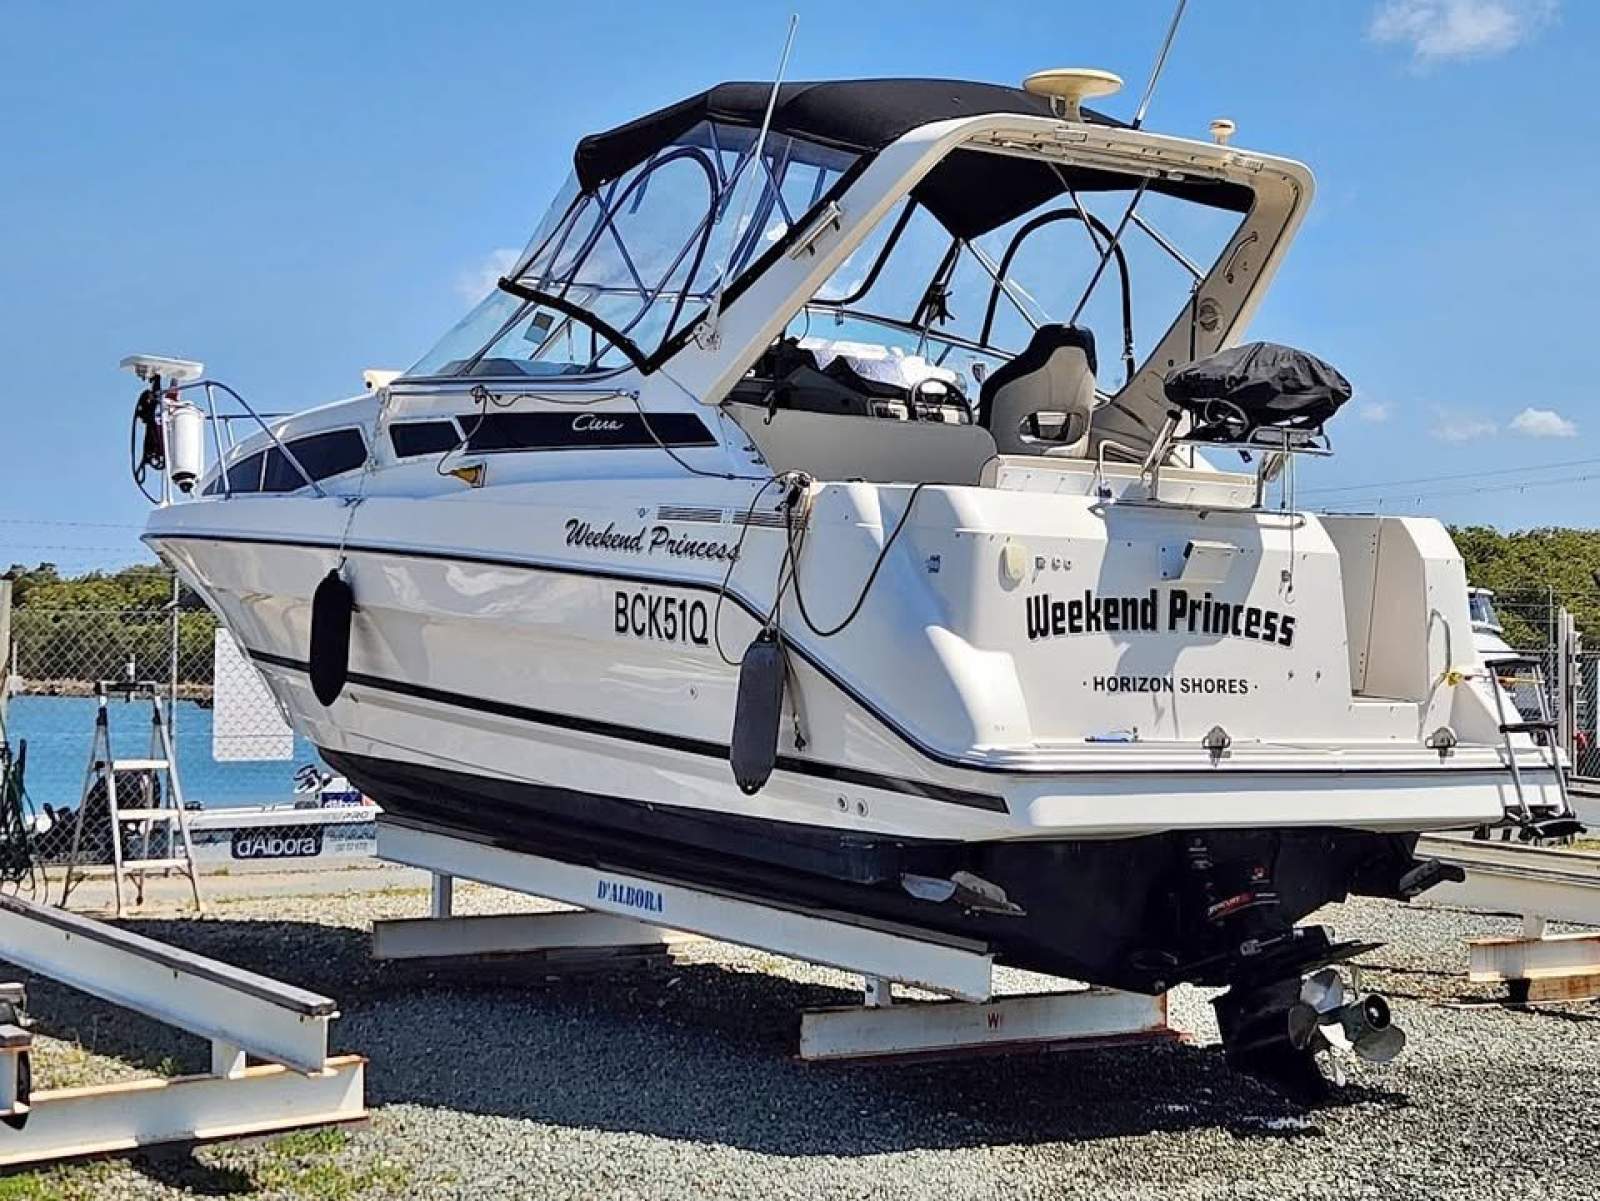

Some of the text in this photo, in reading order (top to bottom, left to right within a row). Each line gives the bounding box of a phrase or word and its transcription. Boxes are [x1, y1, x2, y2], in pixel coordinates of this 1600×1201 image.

[565, 518, 741, 561] Weekend Princess
[614, 591, 709, 645] BCK51Q
[1026, 588, 1296, 647] Weekend Princess
[1093, 676, 1249, 694] HORIZON SHORES
[597, 880, 663, 913] D'ALBORA
